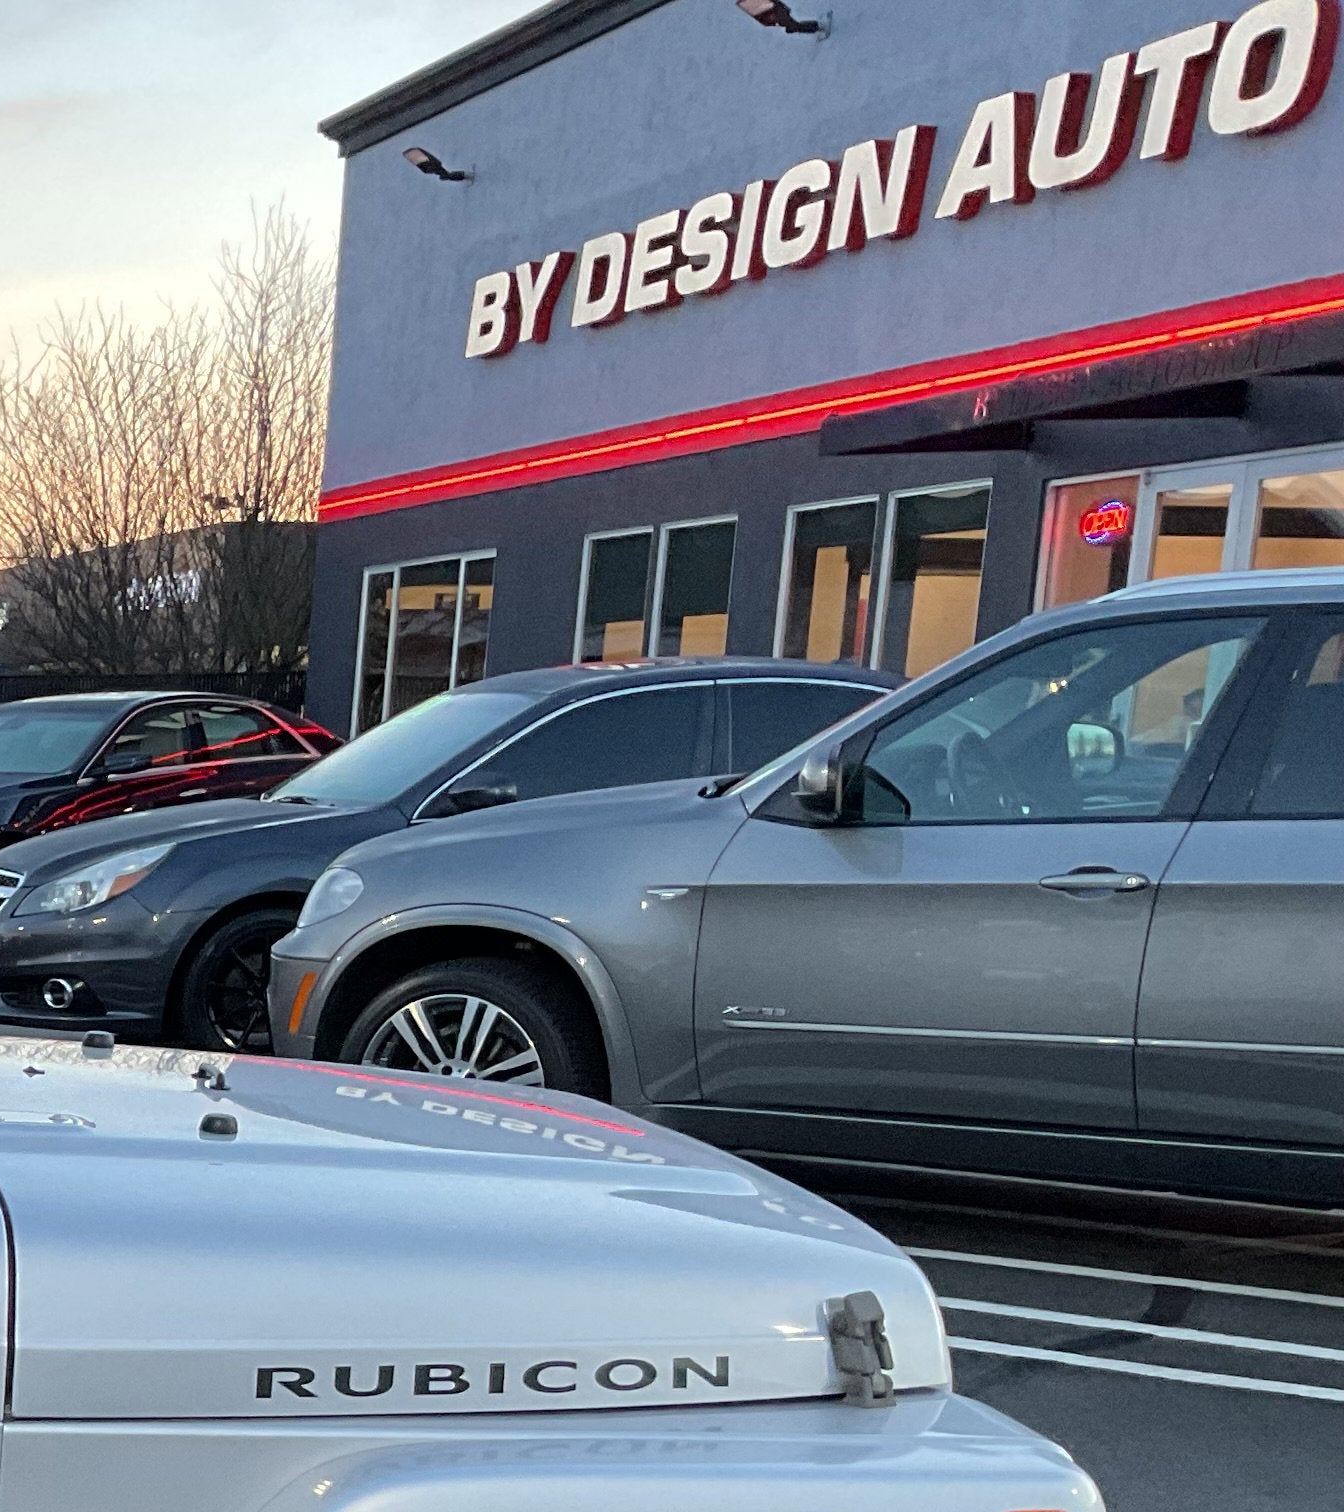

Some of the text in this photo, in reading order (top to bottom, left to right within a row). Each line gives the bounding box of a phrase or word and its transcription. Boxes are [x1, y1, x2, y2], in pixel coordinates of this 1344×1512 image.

[465, 0, 1324, 360] BY DESIGN AUTO
[1083, 506, 1128, 535] OPEN
[255, 1355, 730, 1399] RUBICON
